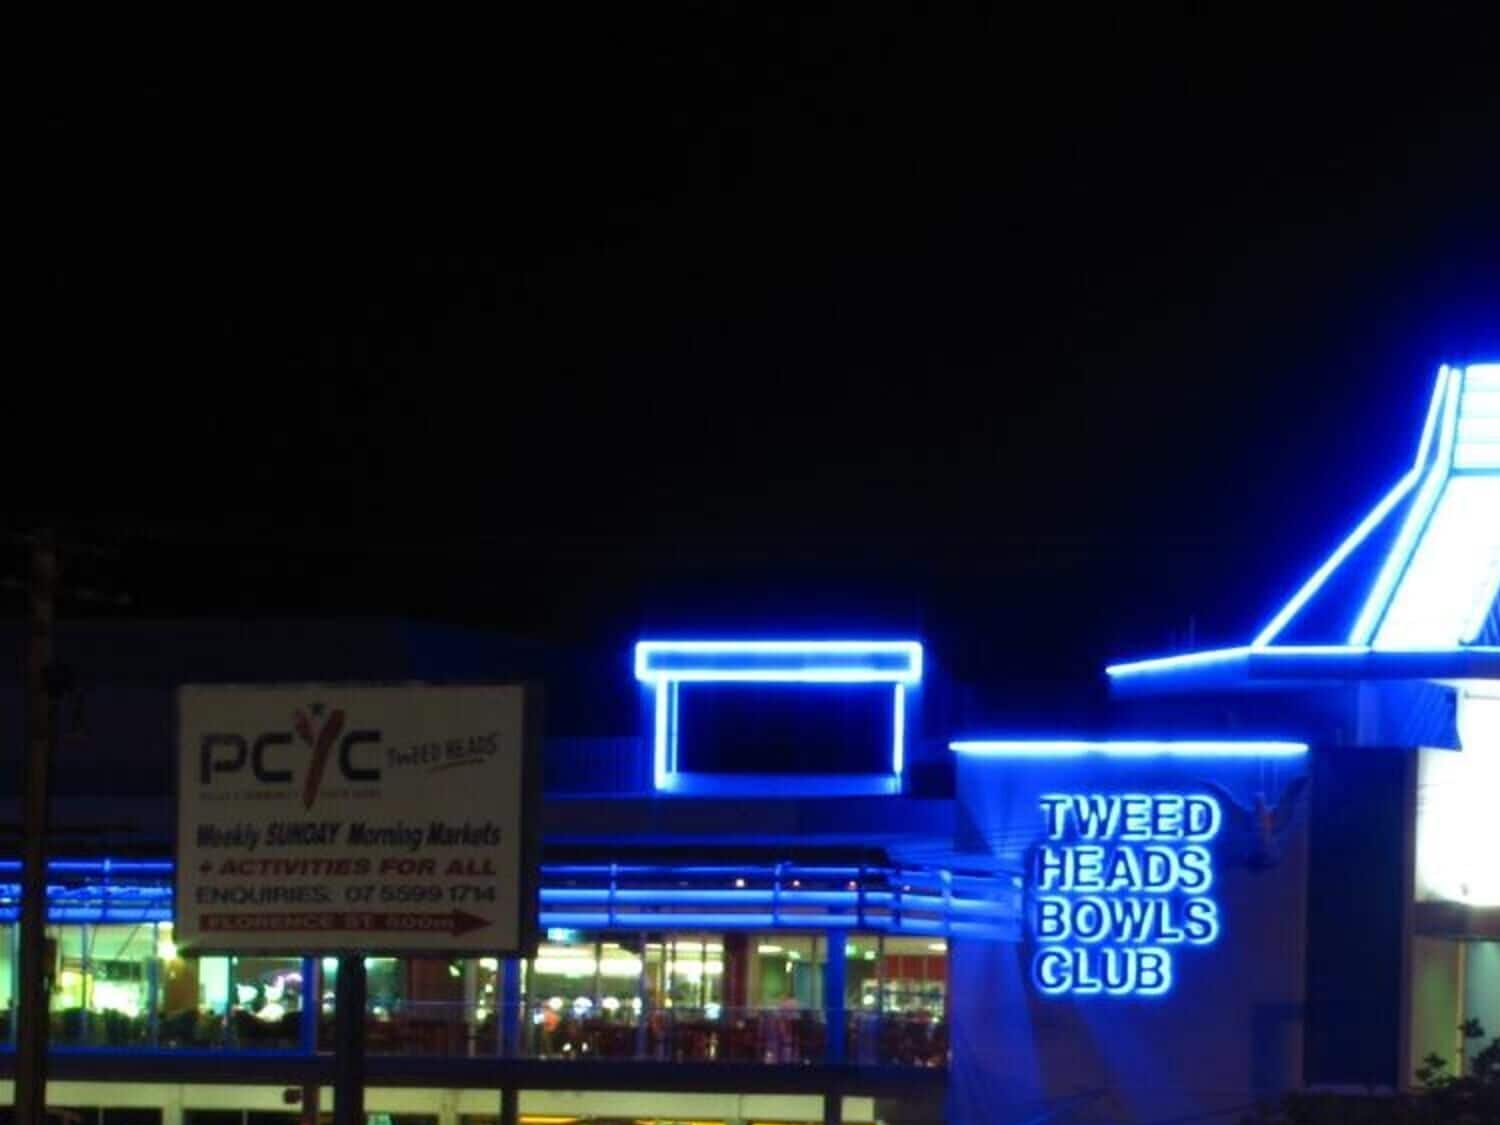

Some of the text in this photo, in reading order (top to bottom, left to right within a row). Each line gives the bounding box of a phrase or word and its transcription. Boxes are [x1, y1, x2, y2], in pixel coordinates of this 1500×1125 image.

[265, 822, 342, 846] SUNDAY
[346, 822, 424, 852] Morning
[426, 821, 503, 846] Markets
[1038, 794, 1221, 841] TWEED
[219, 858, 371, 876] ACTIVITIES
[379, 858, 437, 876] FOR
[445, 858, 497, 876] ALL
[1036, 845, 1213, 893] HEADS
[345, 885, 375, 903] 07
[380, 885, 442, 903] 5599
[448, 885, 496, 903] 1714
[1034, 896, 1219, 944] BOWLS
[1033, 946, 1172, 995] CLUB
